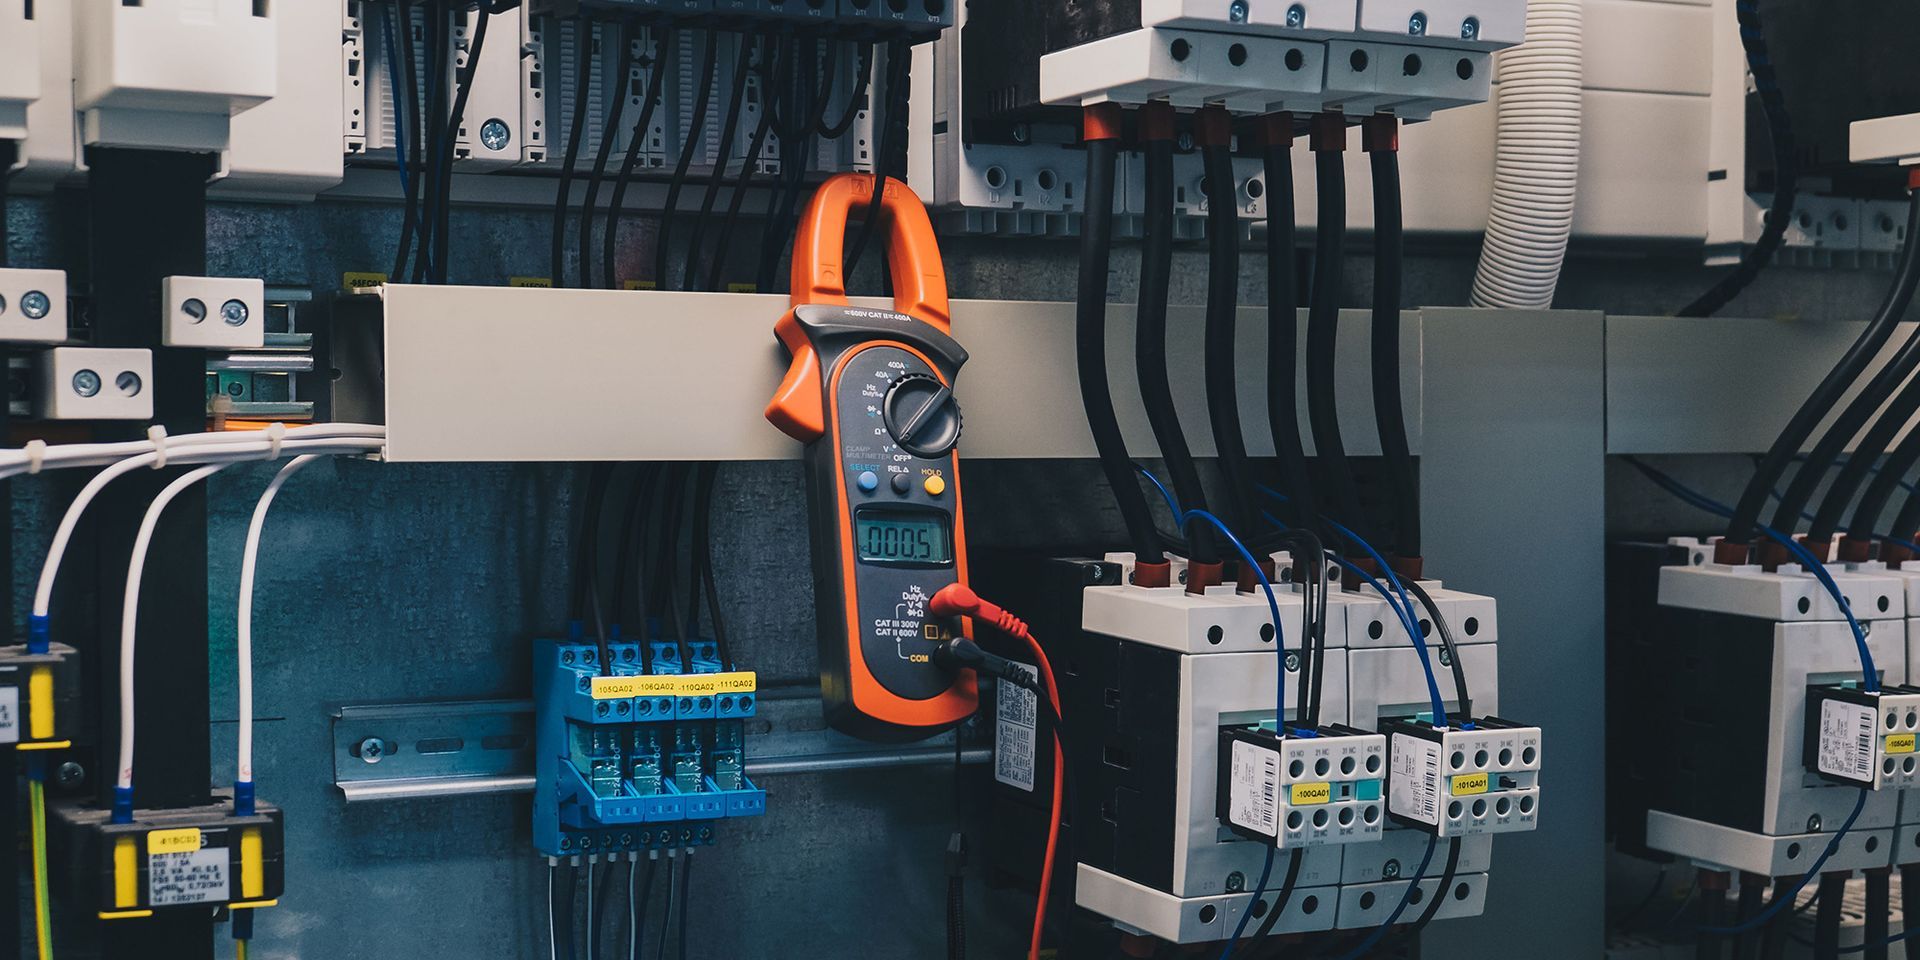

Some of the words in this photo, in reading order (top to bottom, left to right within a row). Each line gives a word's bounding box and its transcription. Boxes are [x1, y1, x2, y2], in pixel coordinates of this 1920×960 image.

[868, 311, 882, 319] CAT
[888, 361, 905, 369] 400A
[875, 371, 889, 379] 40A
[846, 452, 891, 460] MULTIMETER
[893, 454, 908, 462] OFF
[850, 463, 880, 471] SELECT
[888, 465, 902, 473] REL
[921, 468, 942, 476] HOLD
[910, 585, 921, 593] Hz
[875, 619, 891, 627] CAT
[892, 620, 900, 628] III
[901, 620, 919, 628] 300V
[875, 628, 891, 636] CAT
[899, 629, 917, 637] 600V
[910, 654, 929, 662] COM
[638, 683, 675, 691] -106QA02
[678, 683, 715, 692] -110QA02
[717, 680, 753, 688] -111QA02
[596, 685, 634, 694] -105QA02
[1456, 780, 1487, 789] -101QA01
[1297, 789, 1329, 798] -100QA01
